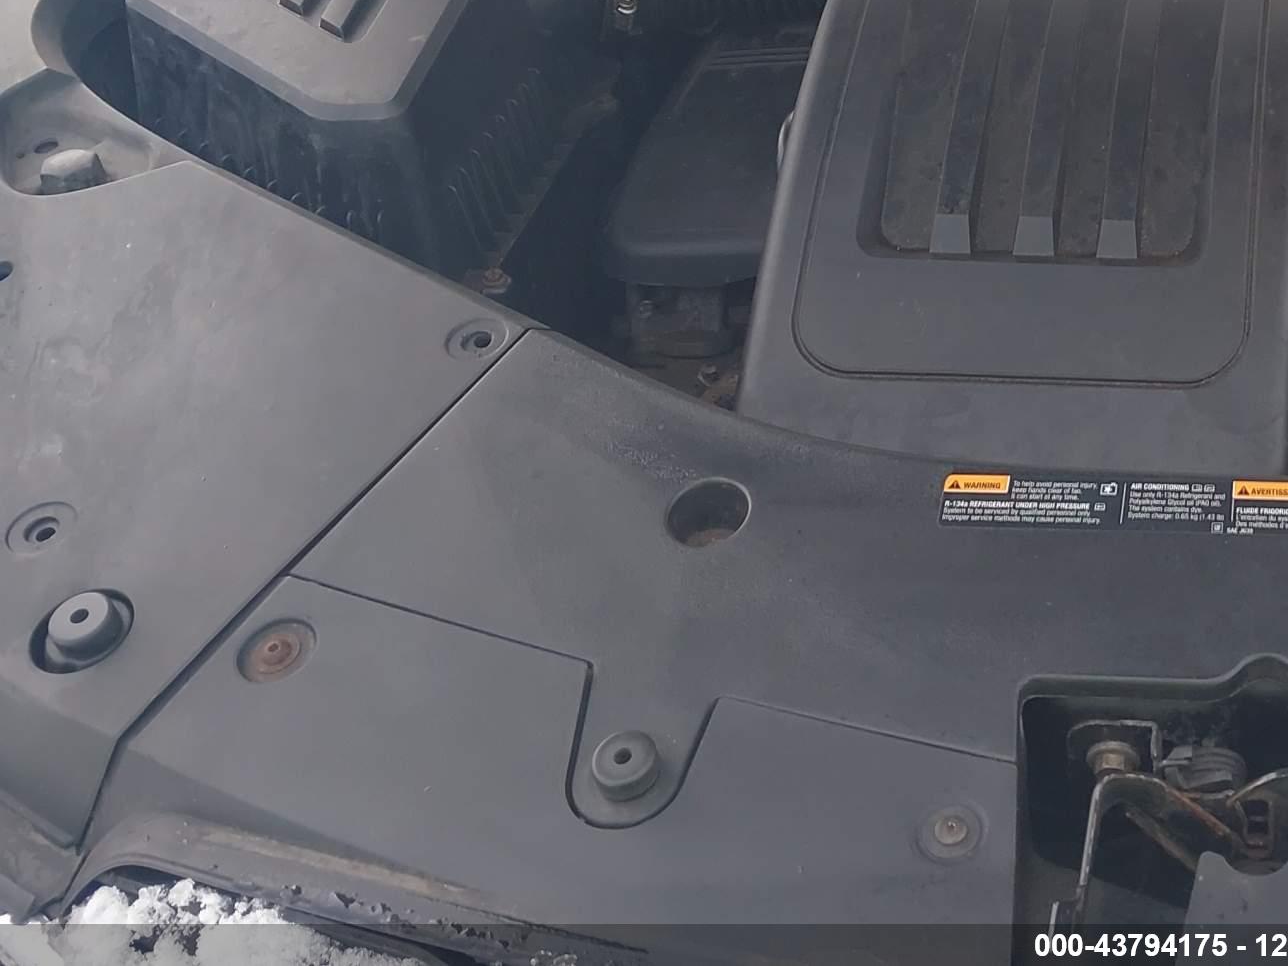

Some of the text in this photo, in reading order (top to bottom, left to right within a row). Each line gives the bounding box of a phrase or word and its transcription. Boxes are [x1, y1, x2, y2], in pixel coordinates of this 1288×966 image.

[964, 481, 1000, 489] WARNING
[1144, 483, 1189, 491] CONDITIONING
[1016, 501, 1037, 509] UNDER
